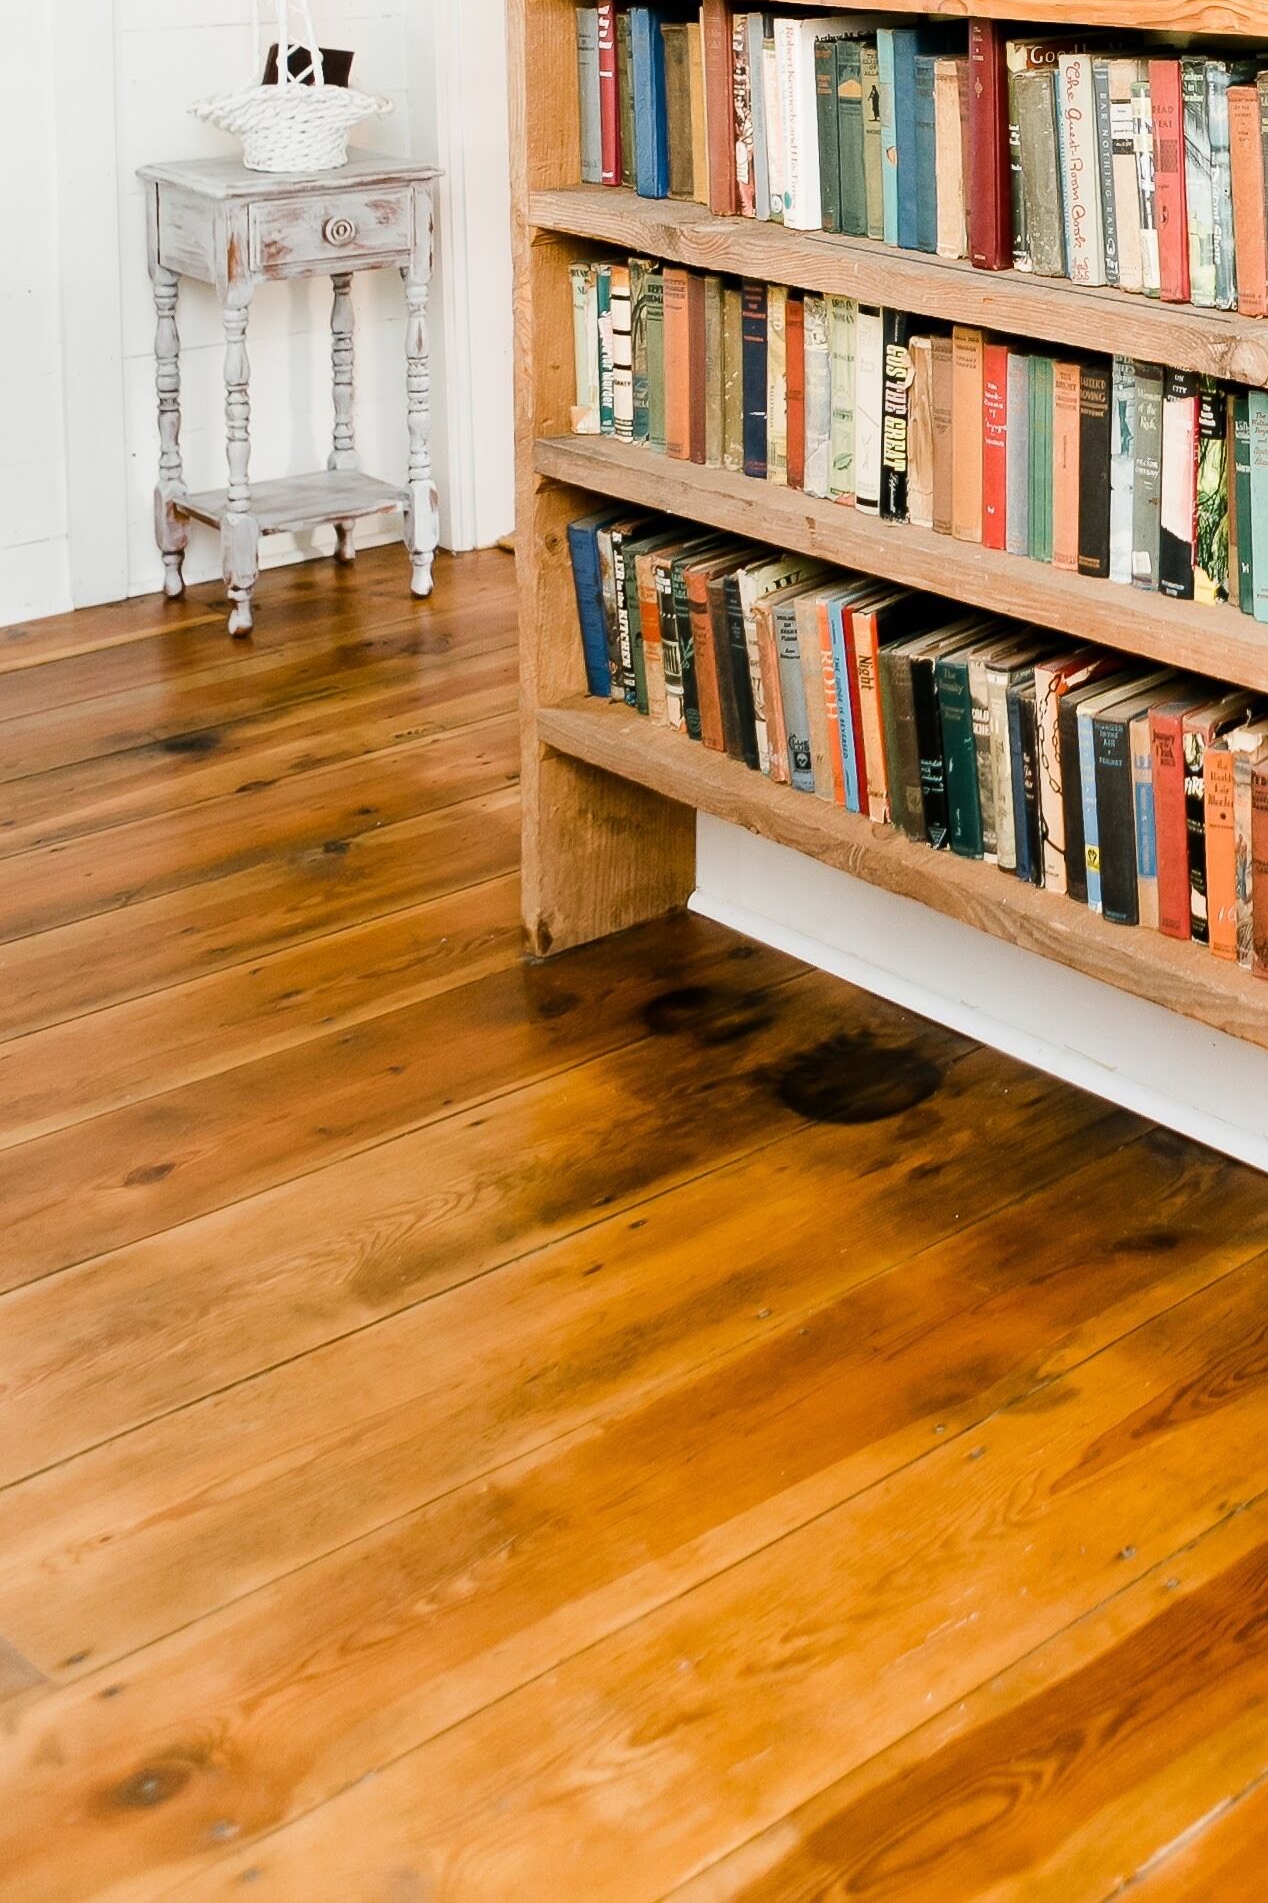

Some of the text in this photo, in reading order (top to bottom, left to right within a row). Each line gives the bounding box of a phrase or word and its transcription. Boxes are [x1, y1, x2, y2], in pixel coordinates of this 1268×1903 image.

[1102, 129, 1111, 198] NOTHING
[883, 344, 907, 471] GUS THE GREAT
[820, 650, 836, 719] ROTH
[858, 654, 873, 690] Night
